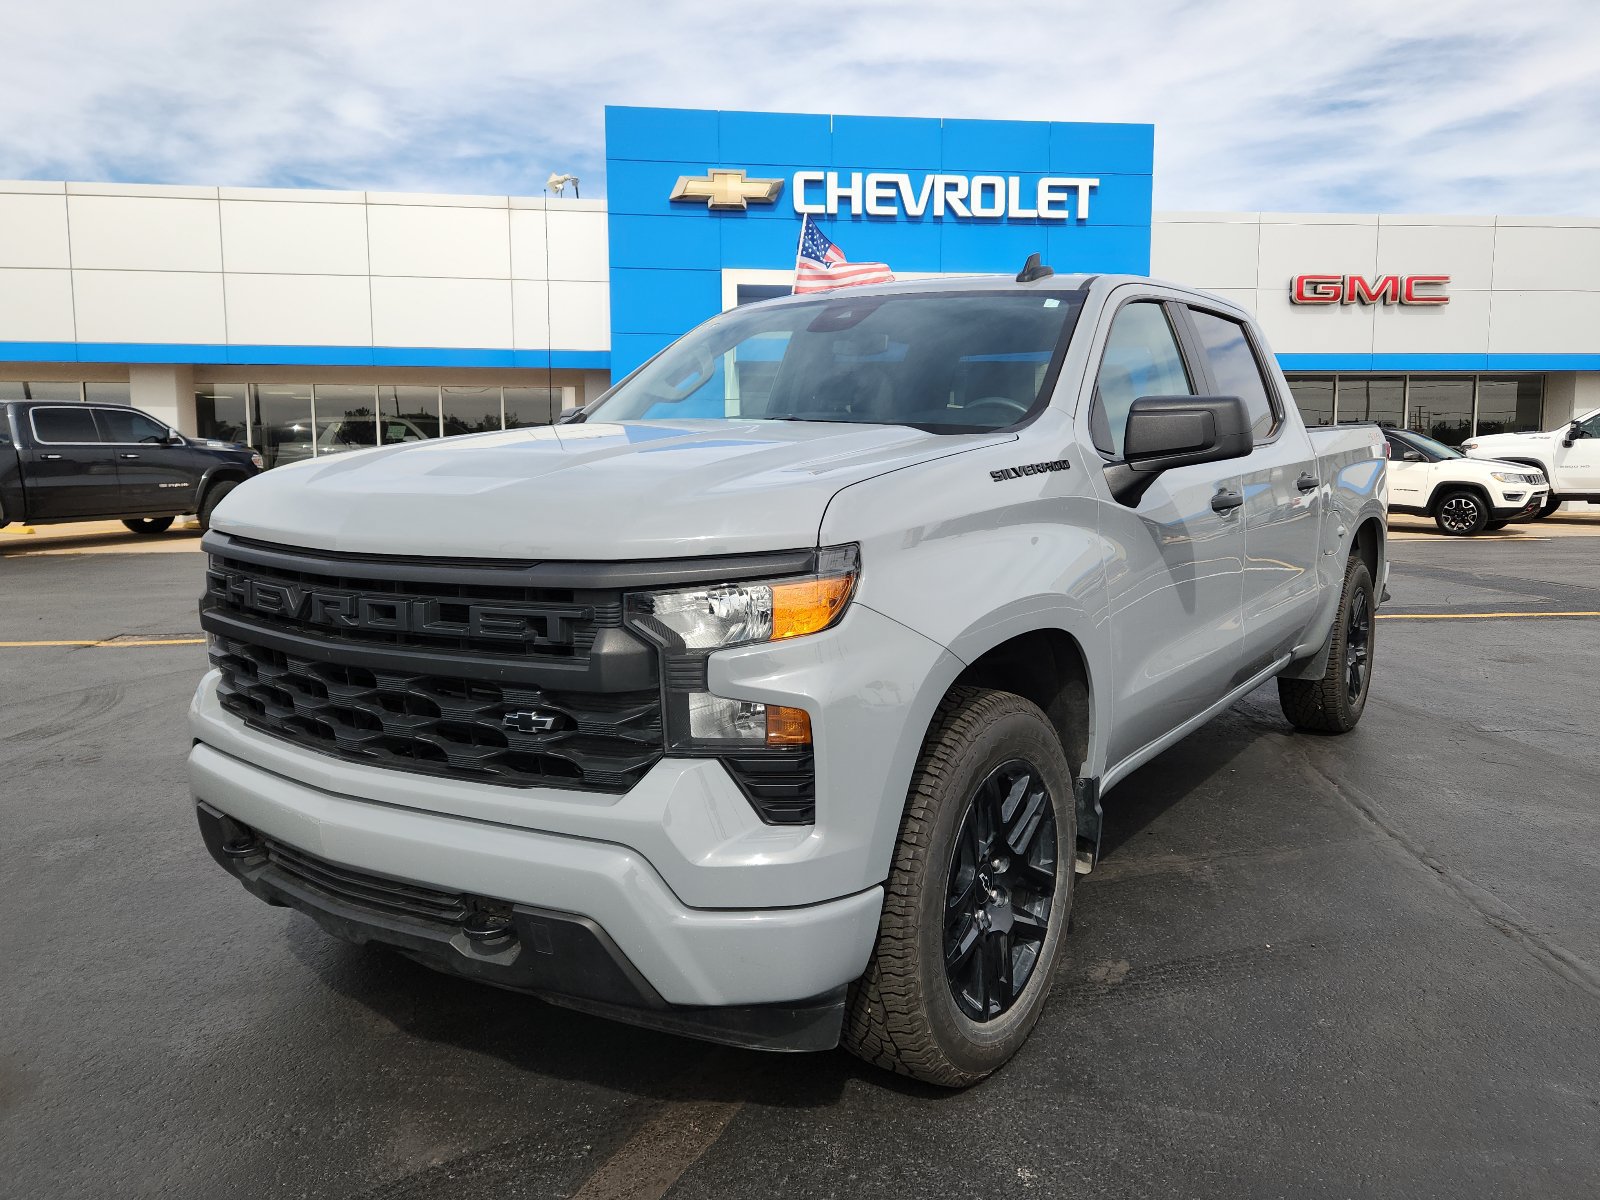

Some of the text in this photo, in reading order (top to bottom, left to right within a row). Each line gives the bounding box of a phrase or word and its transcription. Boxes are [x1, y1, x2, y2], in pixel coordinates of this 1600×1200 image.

[793, 171, 1099, 219] CHEVROLET
[1290, 274, 1450, 305] GMC
[990, 459, 1071, 482] SILVERADO
[206, 568, 596, 645] CHEVROLET
